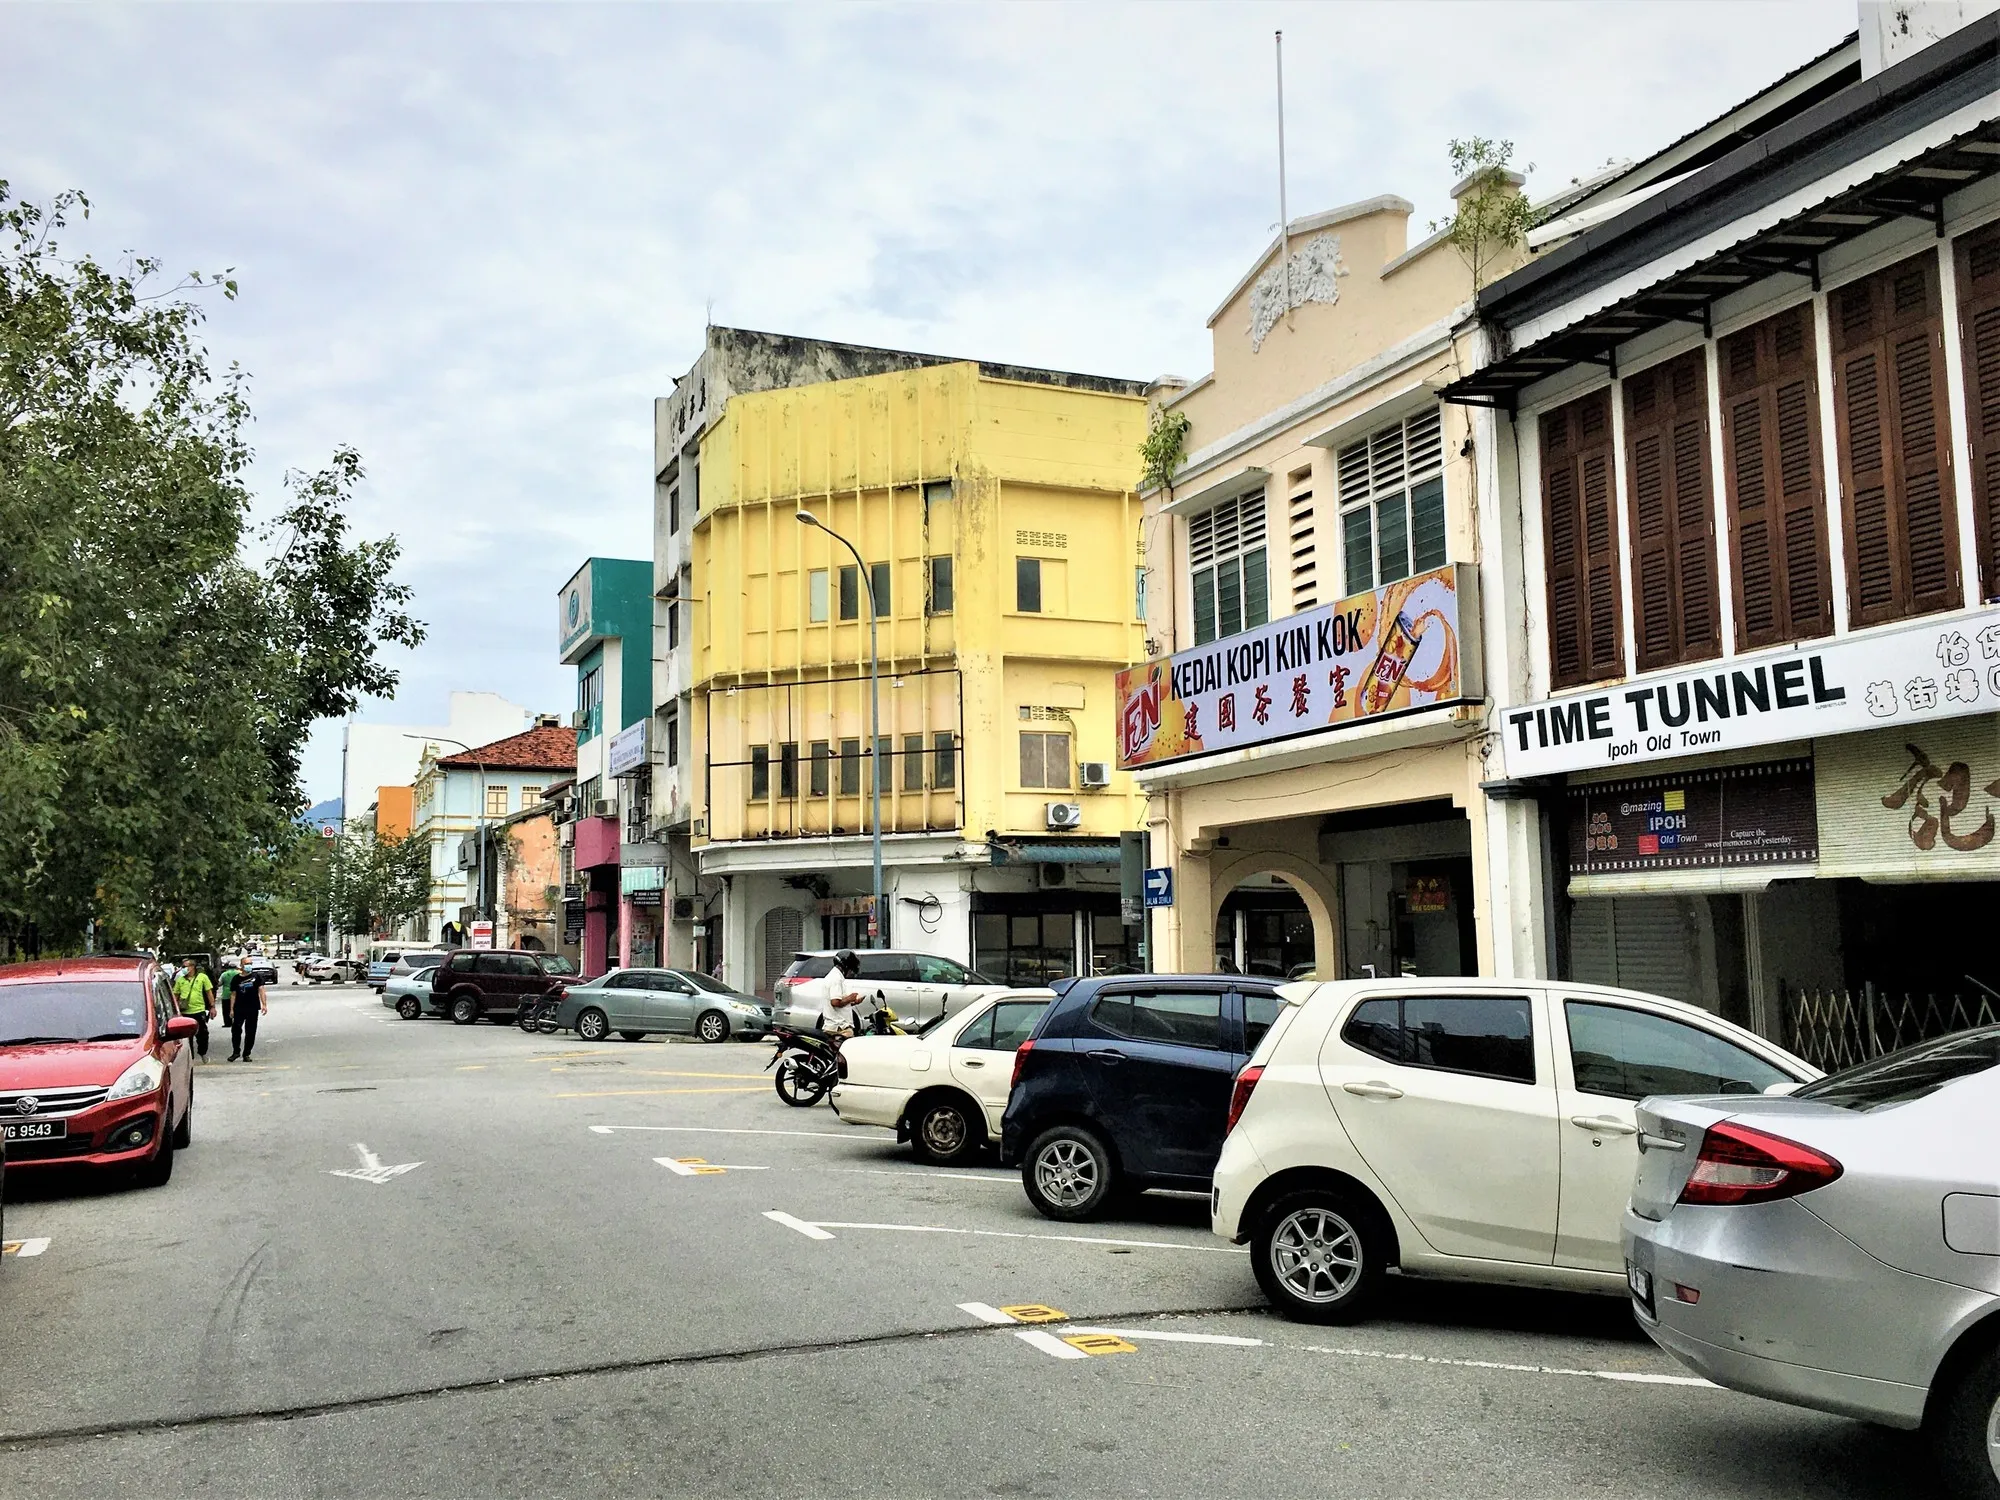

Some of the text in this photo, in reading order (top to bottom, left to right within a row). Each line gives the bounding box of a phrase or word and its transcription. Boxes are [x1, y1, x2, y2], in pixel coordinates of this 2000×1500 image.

[1171, 608, 1364, 701] KEDAI KOPI KIN KOK
[1509, 655, 1846, 751] TIME TUNNEL
[1607, 727, 1721, 761] Ipoh Old Town
[1621, 800, 1662, 816] @mazing
[1649, 814, 1687, 831] IPOH
[1660, 833, 1698, 844] Old Town
[1730, 828, 1766, 840] Capture the
[1704, 839, 1722, 848] sweet
[1722, 838, 1752, 847] memories
[1753, 837, 1761, 845] of
[20, 1124, 52, 1137] 9543
